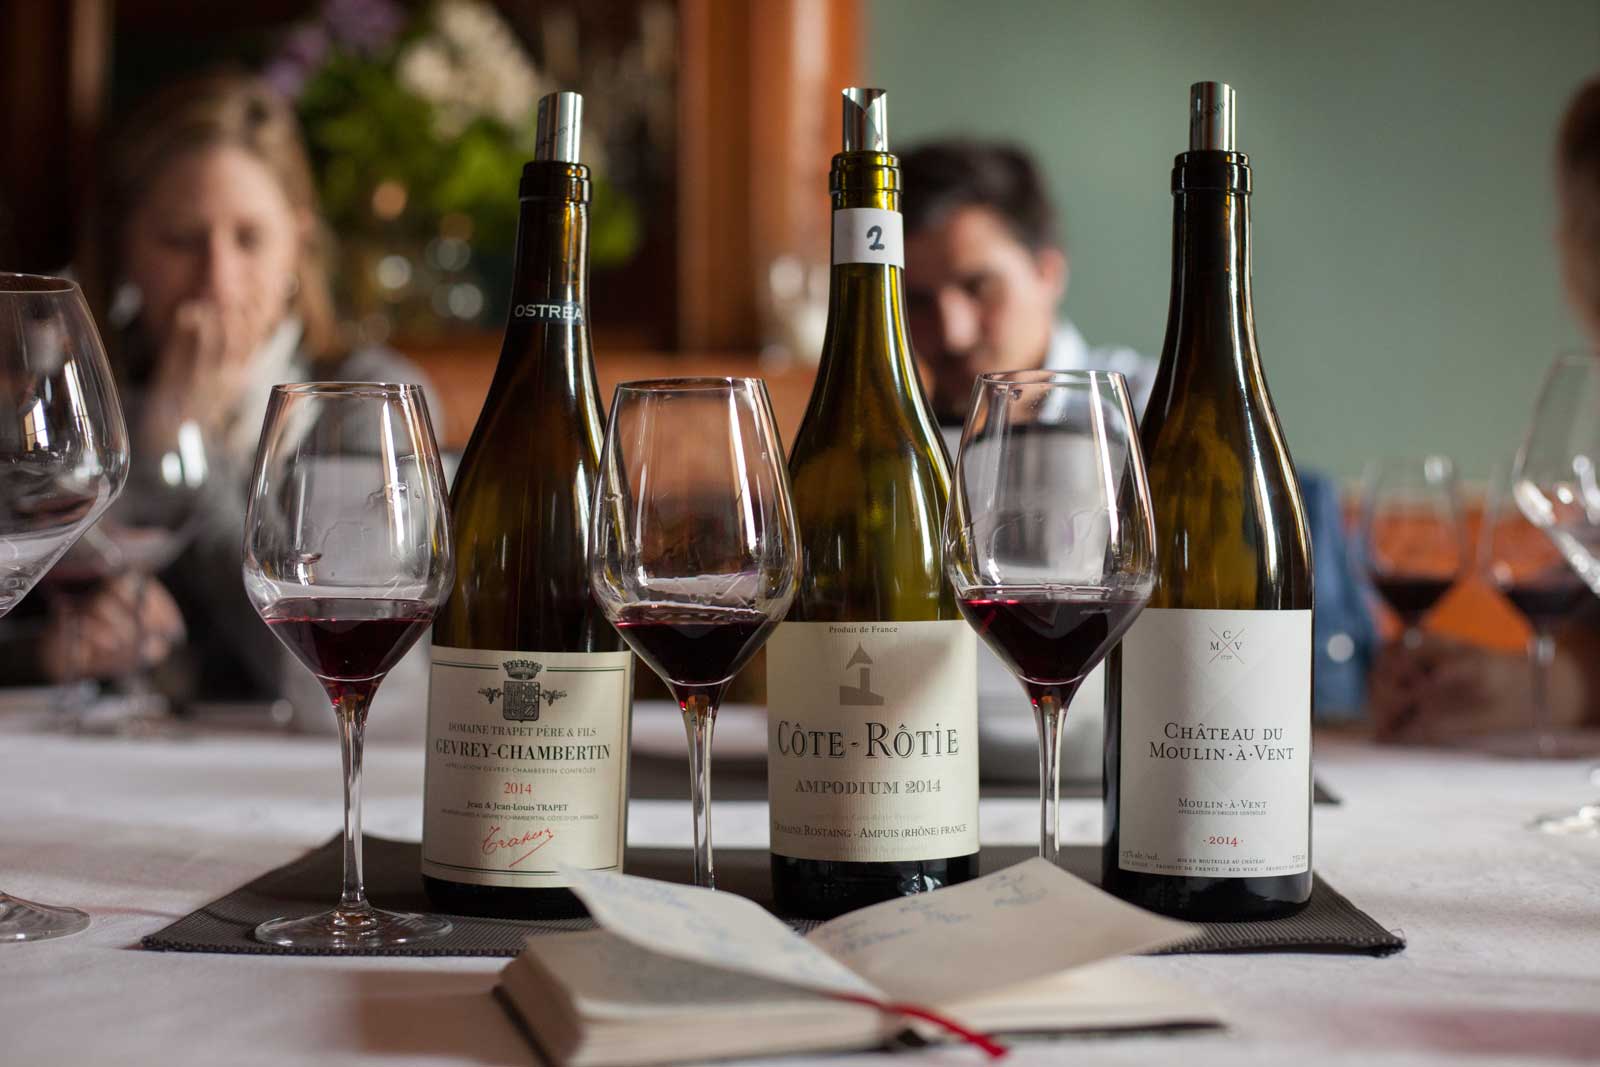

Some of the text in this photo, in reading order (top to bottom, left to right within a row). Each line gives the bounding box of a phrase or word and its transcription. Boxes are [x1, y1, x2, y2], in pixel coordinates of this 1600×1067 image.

[866, 225, 885, 251] 2
[514, 303, 583, 320] OSTREA
[829, 625, 898, 633] Produit de France
[1223, 630, 1231, 639] C
[1210, 641, 1242, 650] M V
[448, 721, 598, 737] DOMAINE TRAPET PÈRE & FILS
[1164, 722, 1284, 741] CHÂTEAU DU
[436, 738, 610, 760] GEVREY-CHAMBERTIN
[504, 781, 532, 795] 2014
[795, 779, 942, 795] AMPODIUM 2014
[467, 800, 568, 811] Jean & Jean-Louis TRAPET
[804, 825, 851, 838] ROSTAING
[860, 827, 899, 838] AMPUIS
[901, 826, 939, 838] (RHÔNE)
[940, 823, 967, 836] FRANCE
